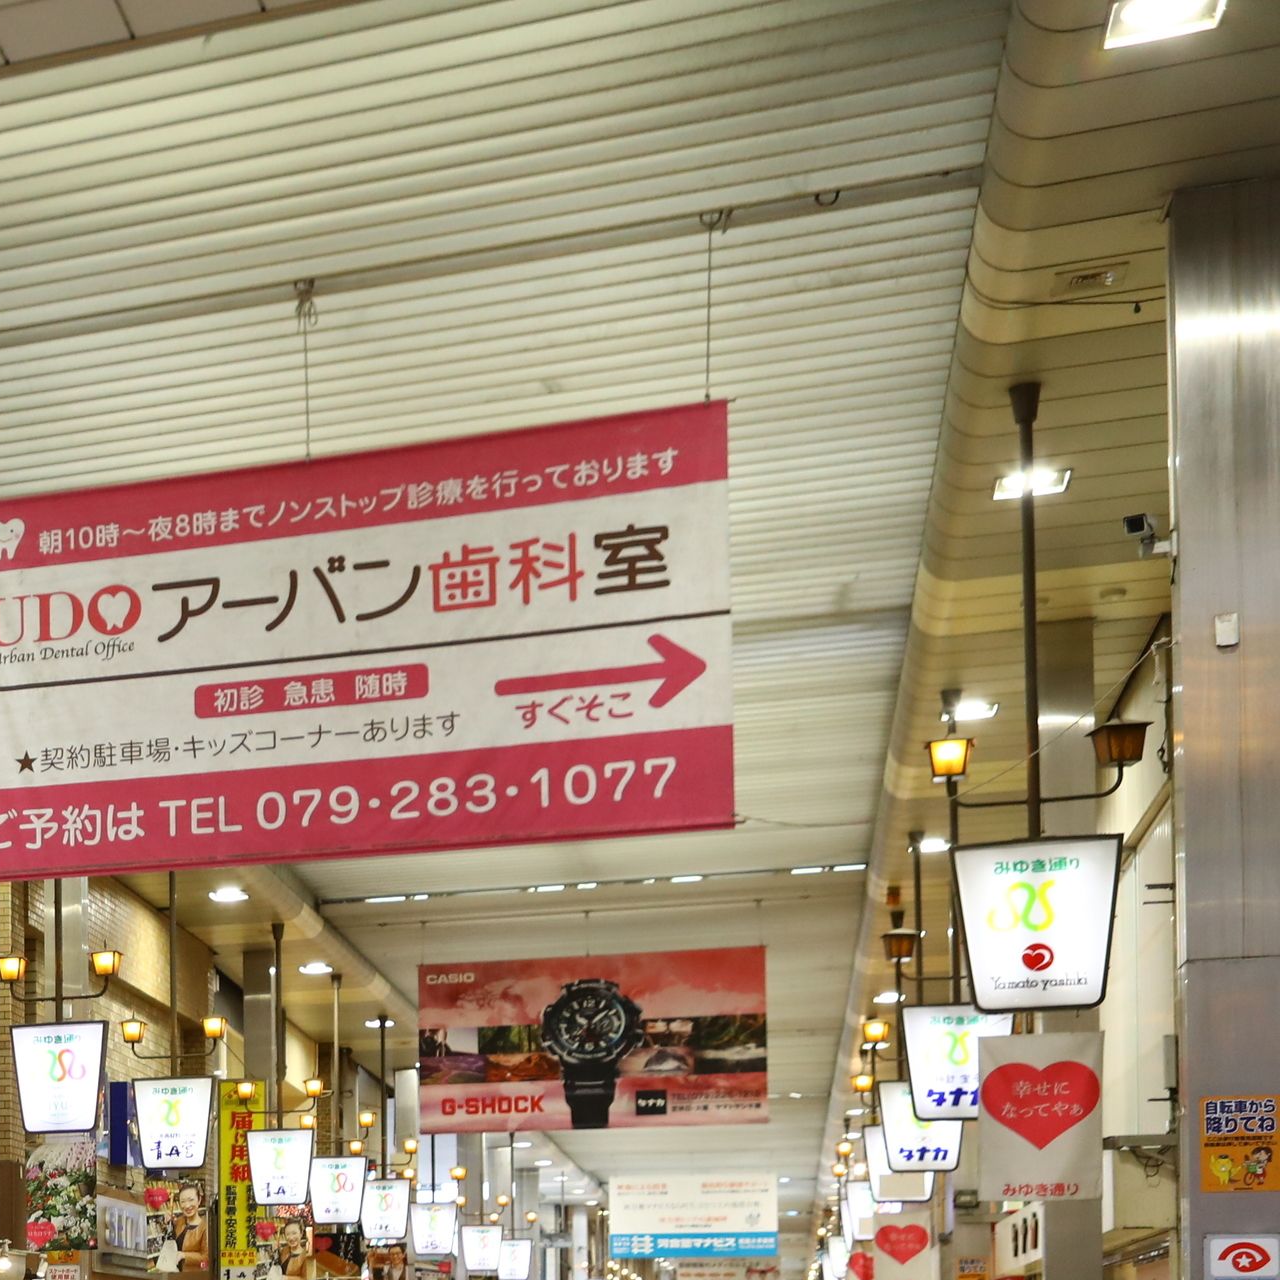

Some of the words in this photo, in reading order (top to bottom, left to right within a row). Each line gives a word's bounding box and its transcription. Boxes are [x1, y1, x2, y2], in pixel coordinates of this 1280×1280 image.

[152, 524, 671, 643] アーバン歯科室
[40, 641, 90, 660] Dental
[94, 637, 135, 661] Office
[214, 684, 265, 713] 初診
[283, 678, 336, 707] 急患
[355, 671, 407, 699] 随時
[515, 692, 634, 730] すぐそこ
[159, 796, 243, 837] TEL
[993, 856, 1080, 874] みゆき通り
[425, 972, 475, 985] CASIO
[1012, 1080, 1071, 1099] 幸せに
[441, 1095, 545, 1116] G-SHOCK
[1204, 1098, 1276, 1115] 自転車から
[1204, 1114, 1277, 1135] 降りてね
[899, 1146, 949, 1161] タナカ
[1002, 1183, 1080, 1197] みゆき通り
